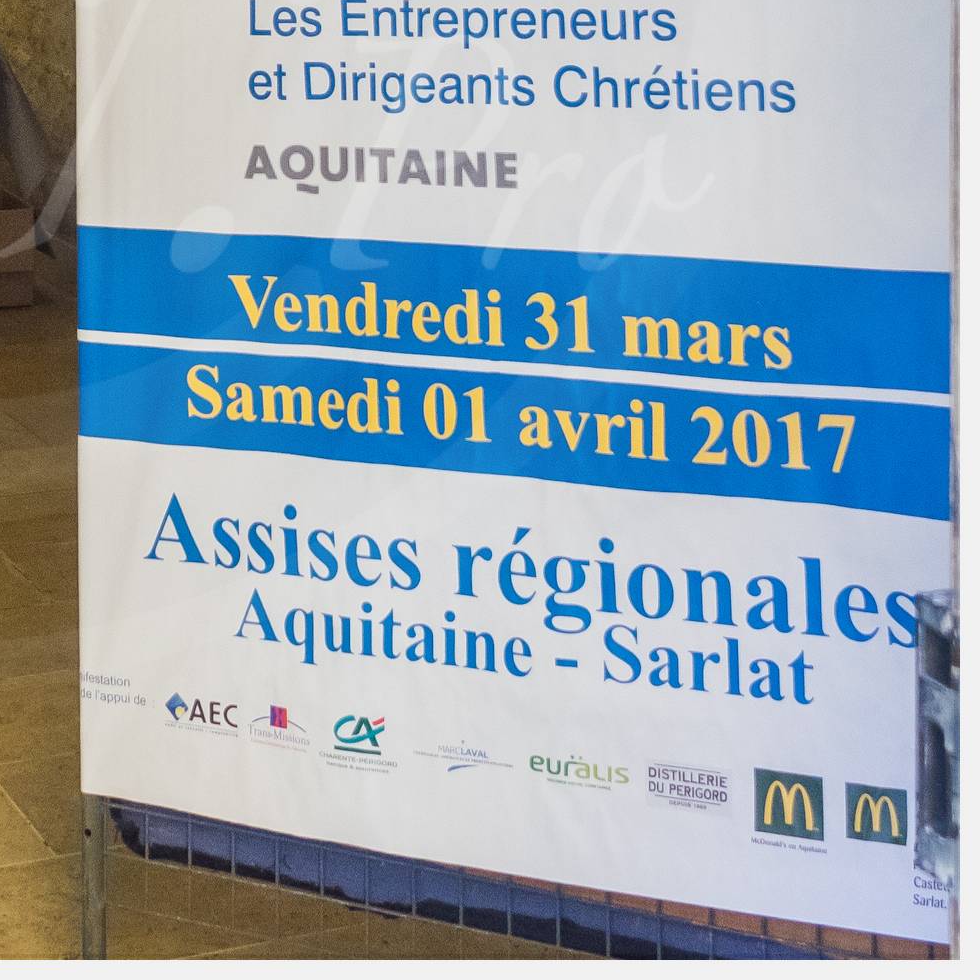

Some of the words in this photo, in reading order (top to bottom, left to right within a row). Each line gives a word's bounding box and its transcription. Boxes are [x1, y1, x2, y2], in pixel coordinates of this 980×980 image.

[248, 64, 286, 101] et
[304, 61, 536, 114] Dirigeants
[553, 64, 797, 113] Chrétiens
[244, 144, 519, 195] AQUITAINE
[228, 274, 505, 348] Vendredi
[524, 291, 595, 353] 31
[622, 314, 794, 370] mars
[186, 363, 401, 435] Samedi
[422, 383, 492, 444] 01
[518, 399, 668, 463] avril
[689, 406, 856, 474] 2017
[145, 492, 423, 592] Assises
[454, 525, 919, 649] régionales
[234, 588, 534, 679] Aquitaine
[602, 625, 816, 706] Sarlat
[134, 694, 147, 706] de
[188, 698, 239, 728] AEC
[648, 766, 728, 789] DISTILLERIE
[648, 780, 665, 794] DU
[669, 783, 728, 803] PERIGORD
[912, 893, 947, 909] Sarlat.
